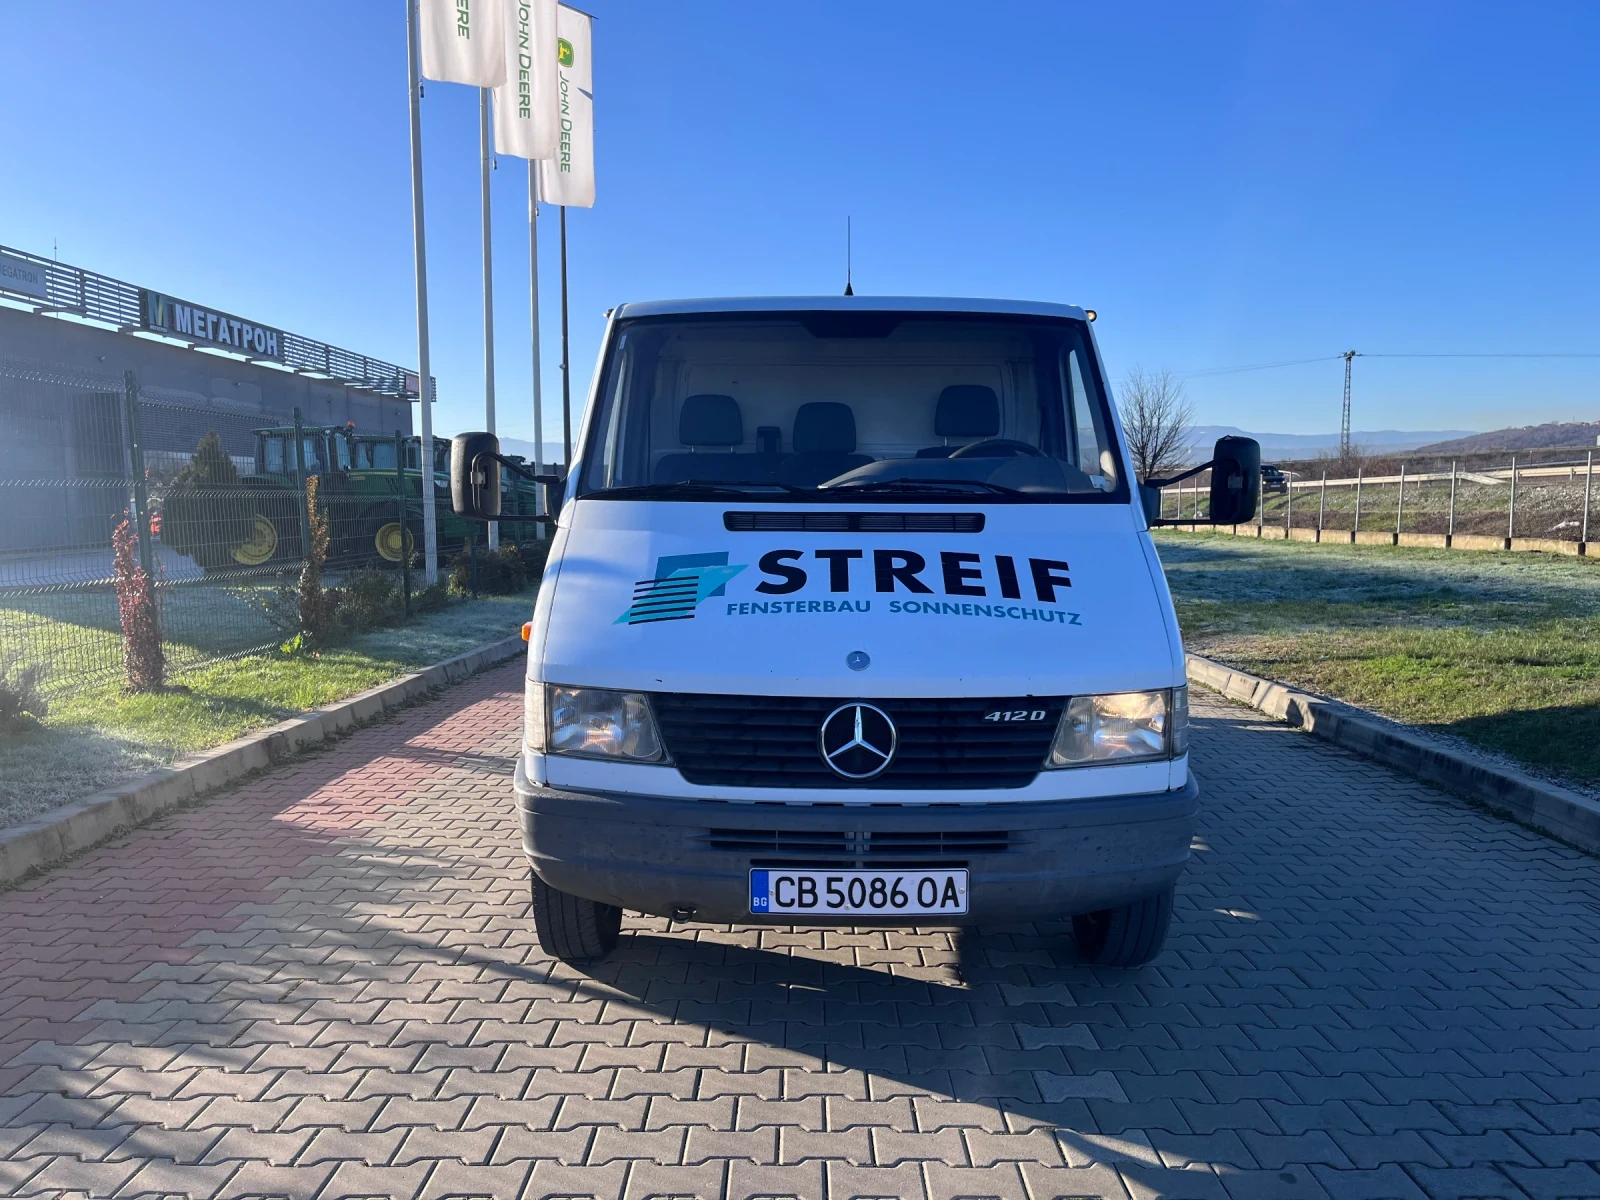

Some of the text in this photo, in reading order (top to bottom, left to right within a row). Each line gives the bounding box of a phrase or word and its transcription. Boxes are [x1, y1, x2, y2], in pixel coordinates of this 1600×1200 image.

[518, 0, 532, 119] JOHN DEERE
[560, 70, 573, 173] JOHN DEERE
[0, 263, 38, 285] EGATRON
[175, 303, 278, 357] МЕГАТРОН
[755, 549, 1072, 603] STREIF
[727, 600, 1083, 626] FENSTERBAU SONNENSCHUTZ
[984, 710, 1027, 722] 412
[753, 896, 768, 907] BG
[774, 876, 819, 908] CB
[826, 876, 909, 909] 5086
